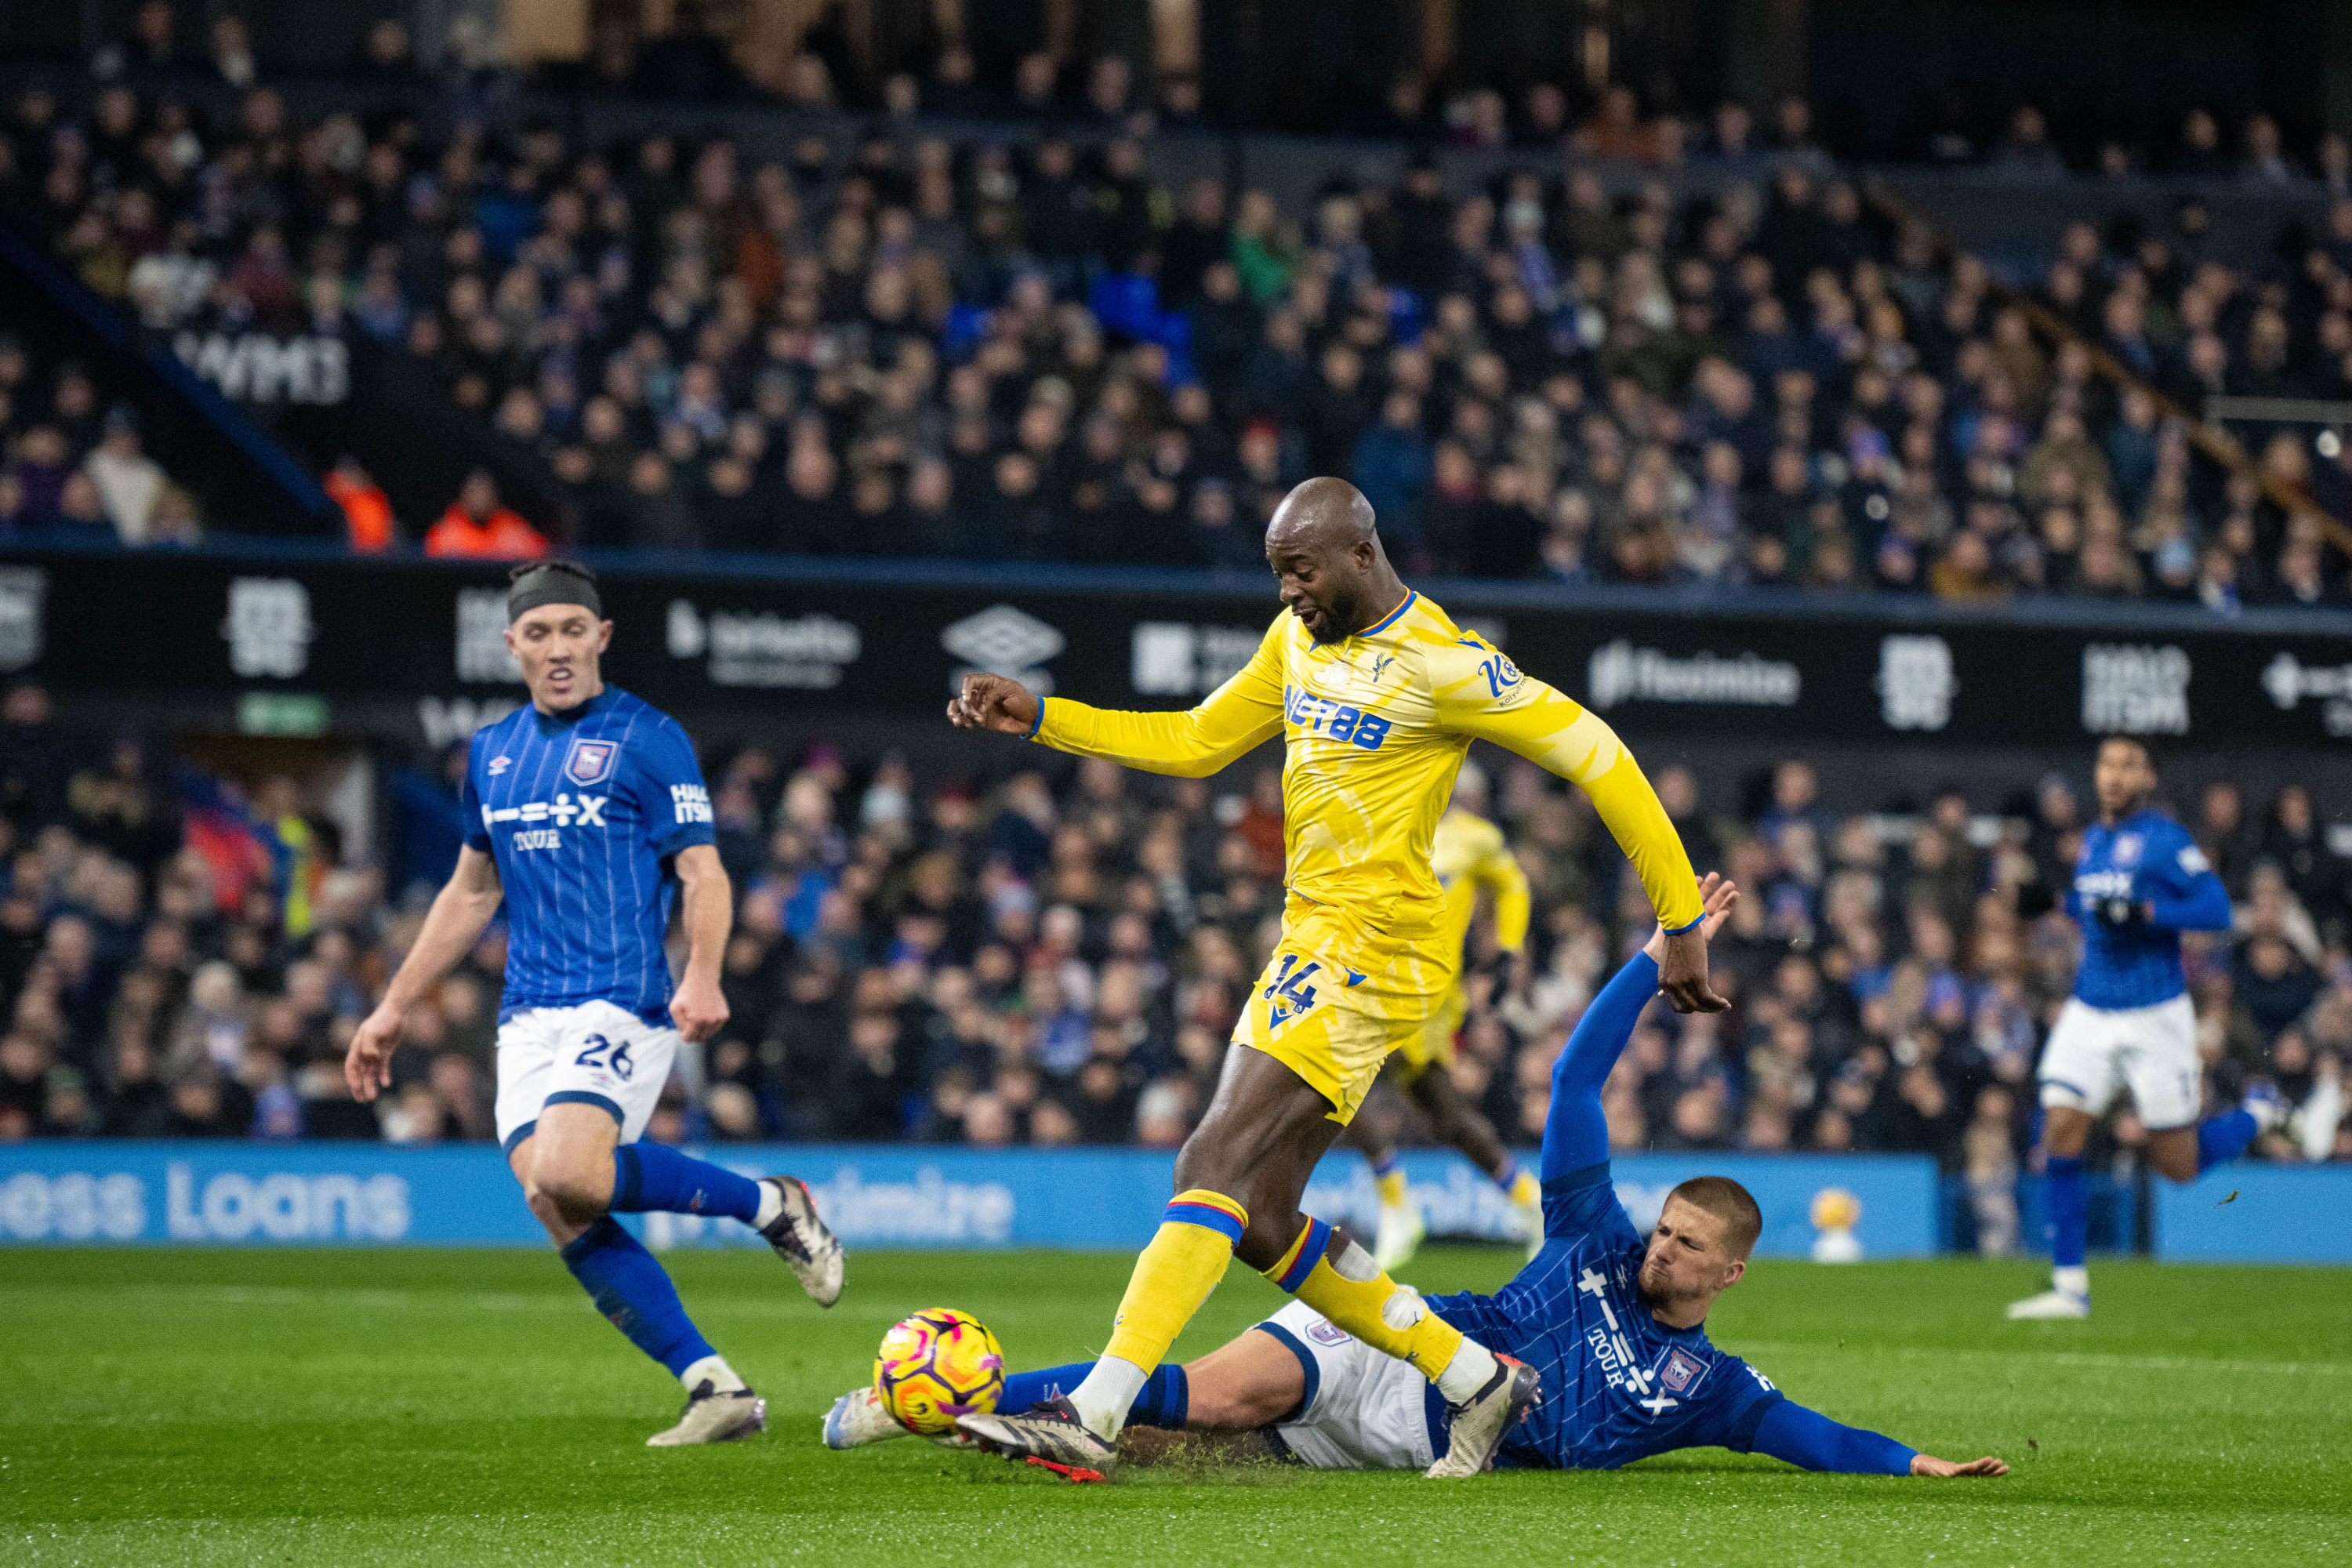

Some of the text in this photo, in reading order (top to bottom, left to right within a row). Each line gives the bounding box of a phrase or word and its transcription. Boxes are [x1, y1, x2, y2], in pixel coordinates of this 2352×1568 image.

[1283, 684, 1392, 750] NET88
[670, 782, 710, 802] HAL
[514, 829, 562, 851] TOUR
[1263, 953, 1323, 1014] 14
[574, 1033, 633, 1083] 26
[166, 1160, 412, 1239] Loans
[1587, 1327, 1625, 1389] TOUR
